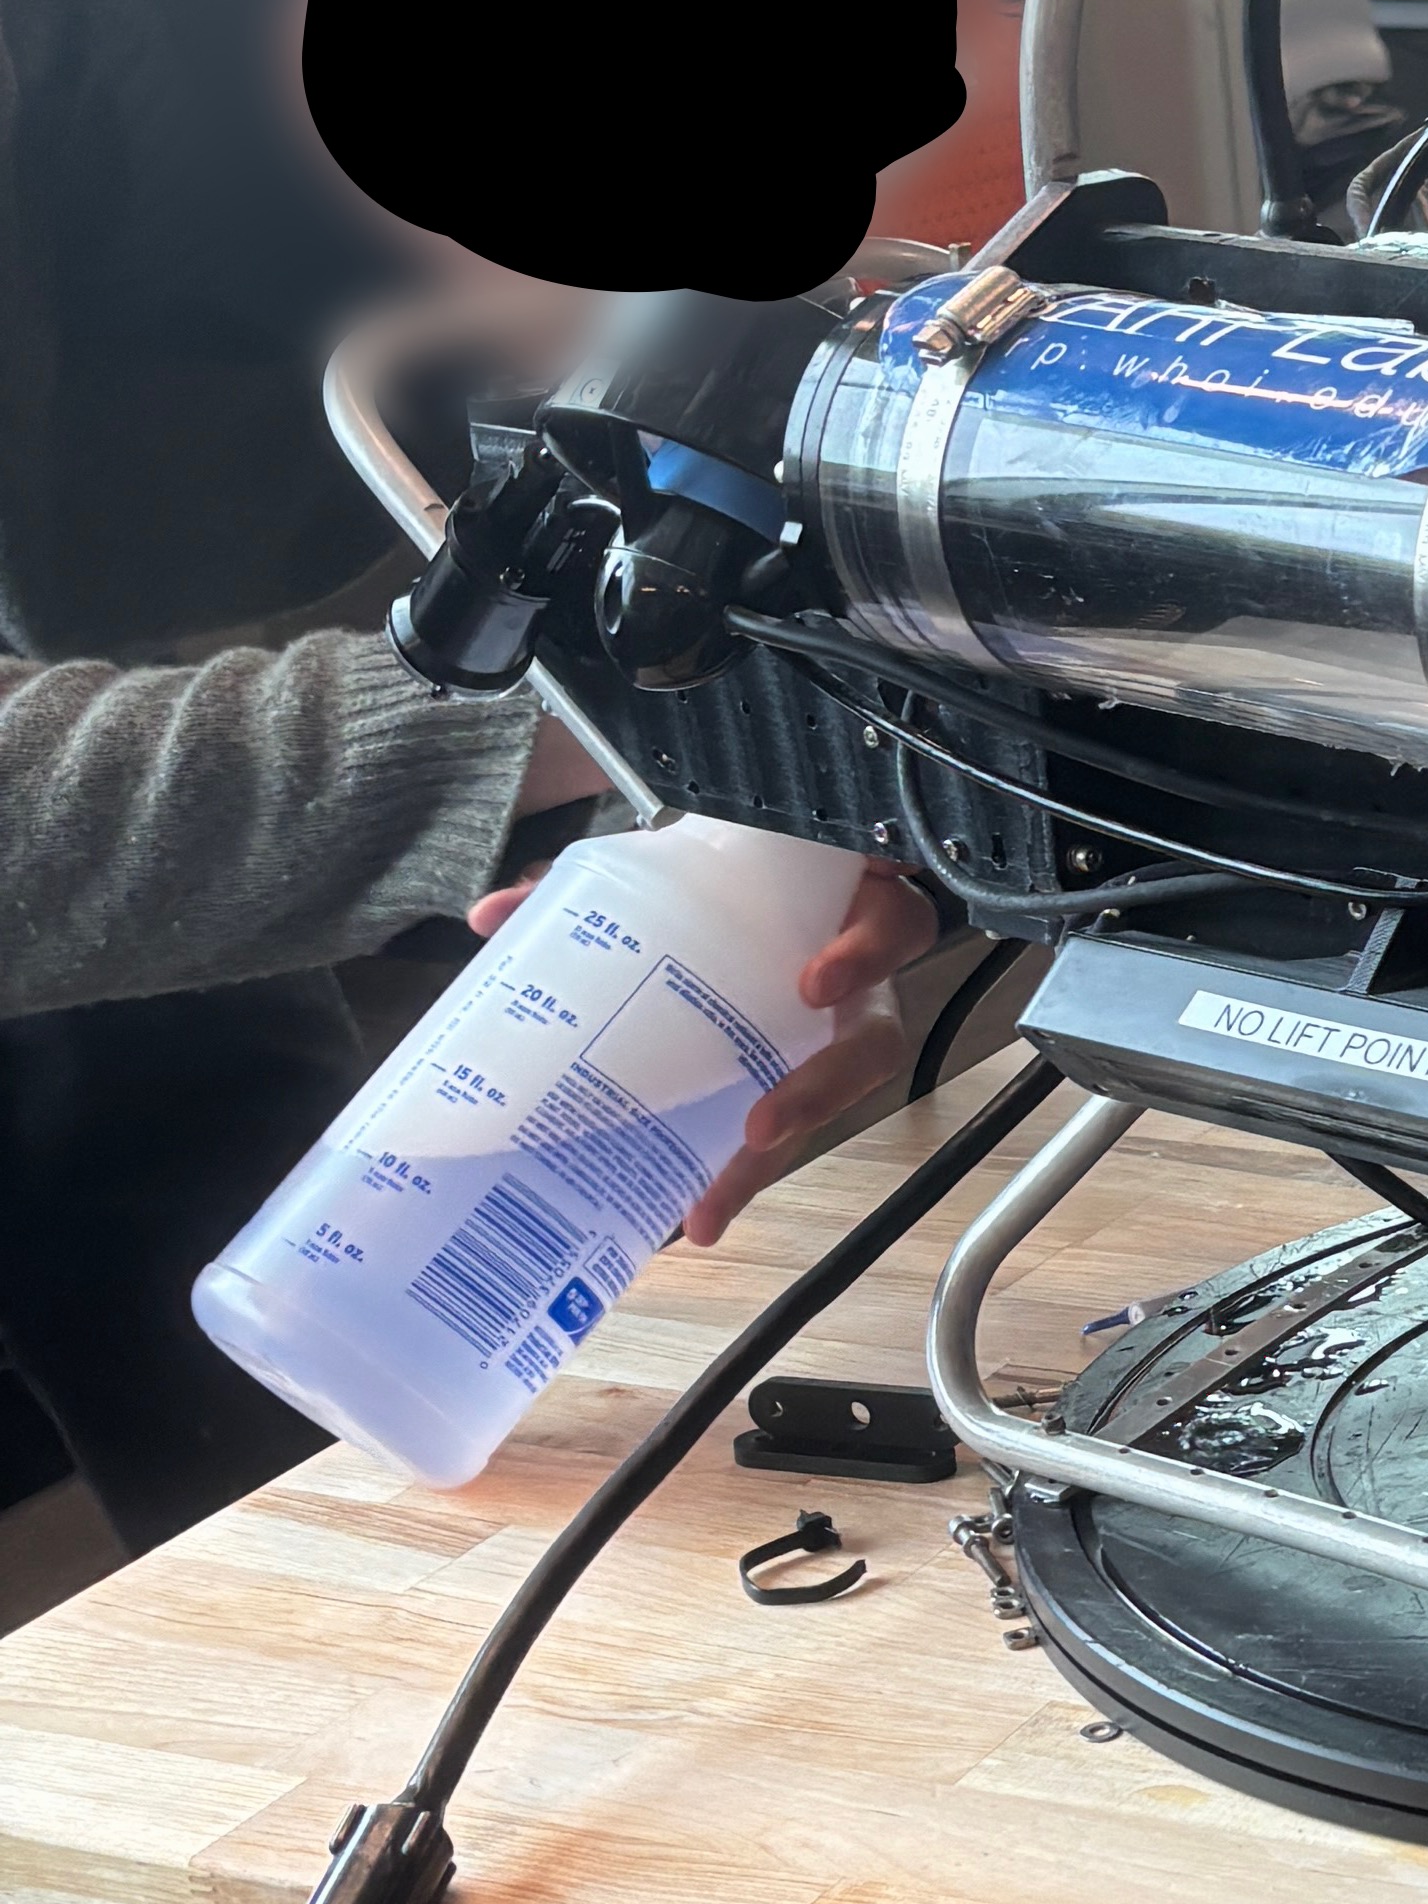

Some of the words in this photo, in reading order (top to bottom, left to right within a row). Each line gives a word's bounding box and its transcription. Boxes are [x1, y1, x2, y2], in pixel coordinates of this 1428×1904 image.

[583, 910, 607, 927] 25
[621, 935, 641, 954] oz.
[520, 984, 543, 1002] 20
[558, 1009, 578, 1028] oz.
[1214, 1004, 1265, 1036] NO
[1267, 1017, 1341, 1053] LIFT
[453, 1064, 472, 1080] 15
[486, 1088, 506, 1107] oz.
[379, 1151, 397, 1168] 10
[412, 1175, 431, 1195] oz.
[316, 1222, 331, 1237] 5
[344, 1244, 364, 1262] oz.
